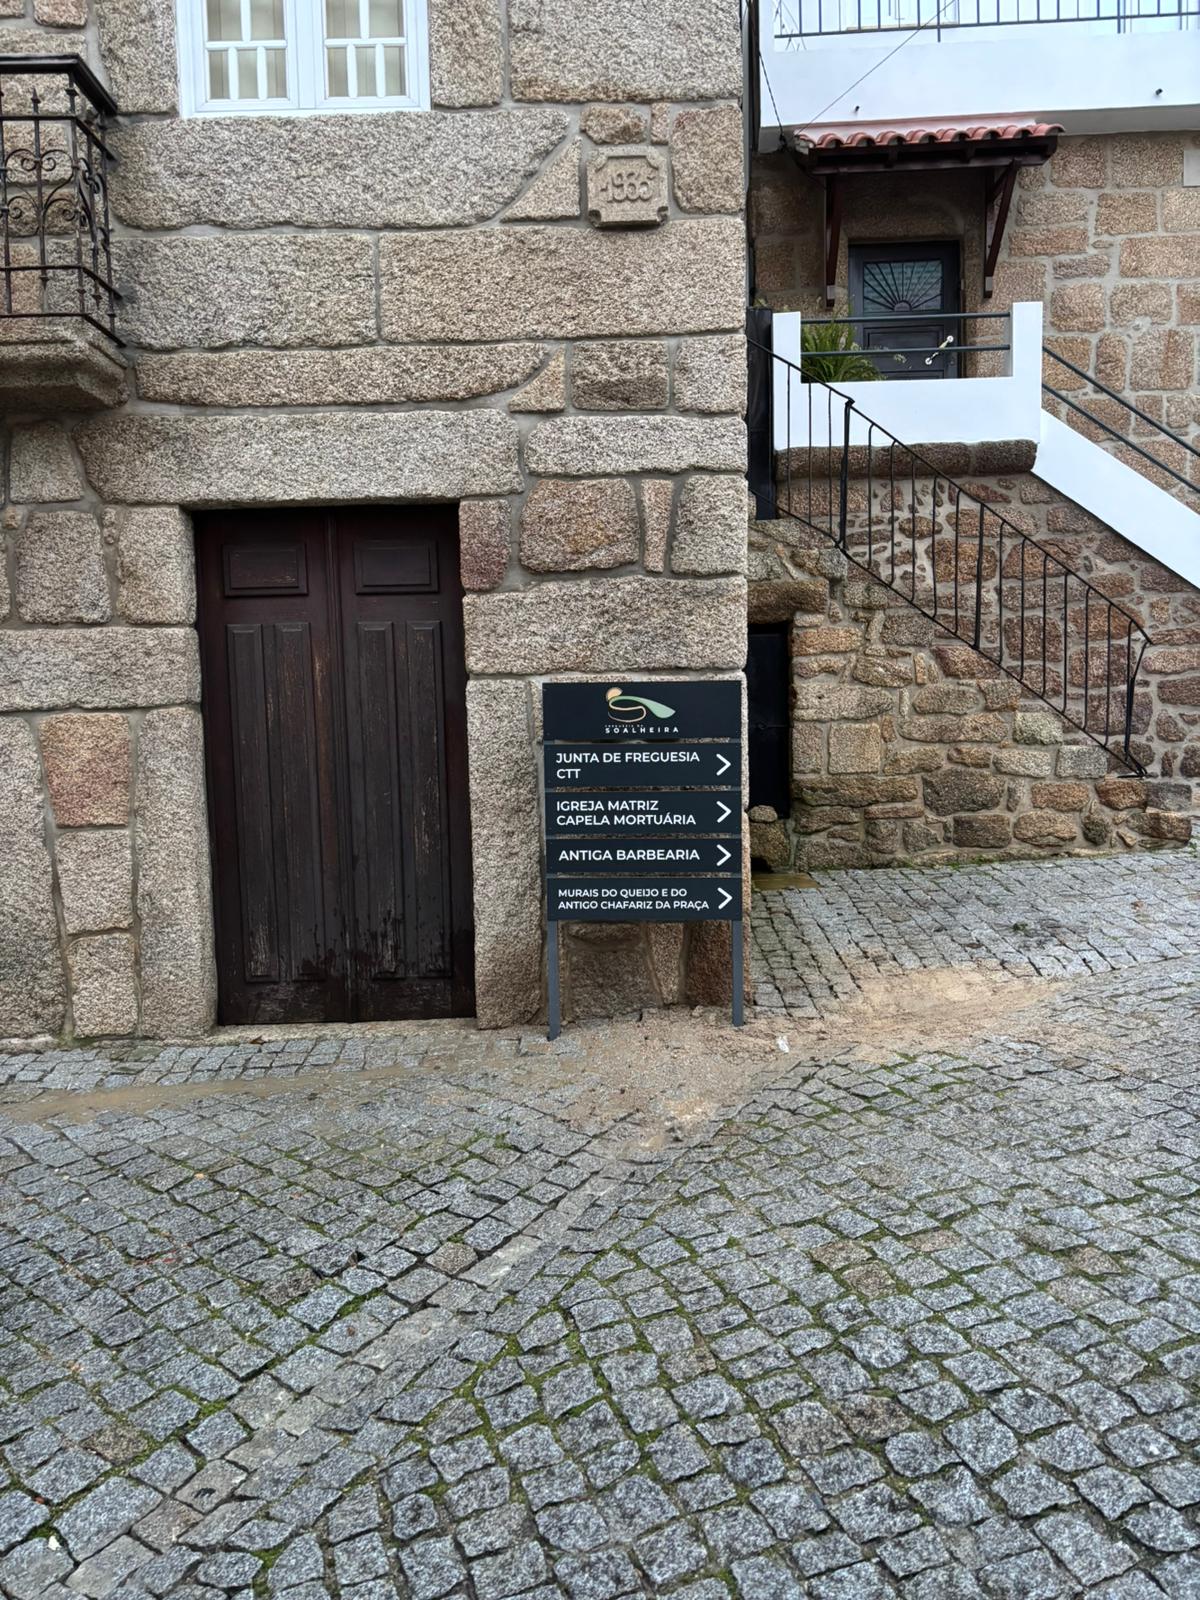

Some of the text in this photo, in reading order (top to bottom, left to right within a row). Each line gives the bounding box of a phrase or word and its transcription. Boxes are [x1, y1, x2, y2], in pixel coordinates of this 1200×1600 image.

[556, 752, 700, 763] JUNTA DE FREGUESIA
[557, 769, 581, 779] CTT
[557, 800, 658, 811] IGREJA MATRIZ
[557, 812, 696, 825] CAPELA MORTUÁRIA
[559, 849, 700, 861] ANTIGA BARBEARIA
[559, 889, 599, 897] MURAIS
[602, 889, 617, 897] DO
[620, 889, 659, 898] QUEIJO
[558, 901, 709, 911] ANTIGO CHAFARIZ DA PRAÇA
